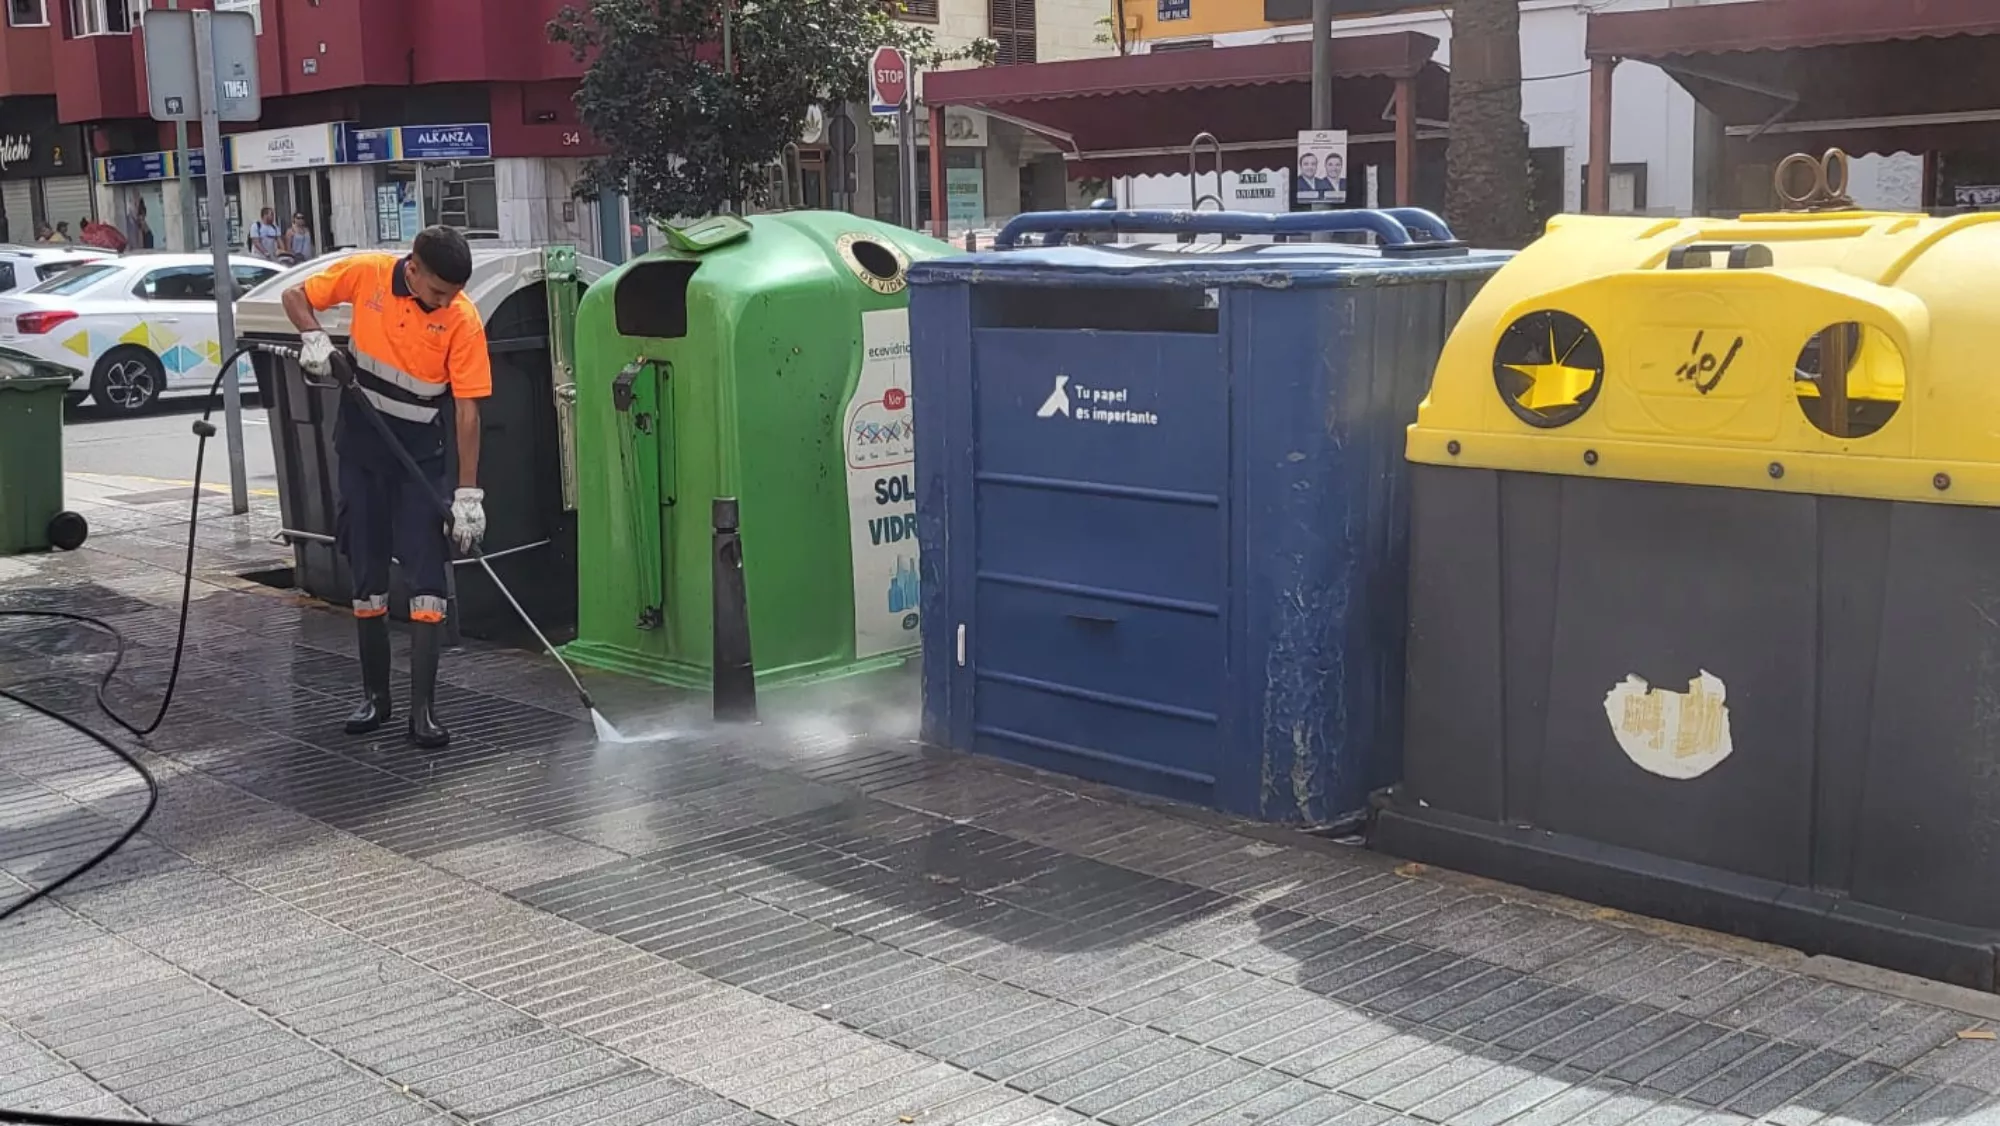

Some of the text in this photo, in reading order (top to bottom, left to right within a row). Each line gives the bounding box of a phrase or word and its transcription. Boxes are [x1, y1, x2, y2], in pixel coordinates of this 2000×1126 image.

[877, 69, 904, 84] STOP
[418, 131, 474, 144] ALKANZA
[562, 131, 580, 146] 34
[1239, 173, 1267, 184] PATIO
[1075, 385, 1127, 405] Tu papel
[1075, 407, 1158, 425] es importante
[874, 474, 915, 505] SOL
[868, 513, 917, 546] VIDR
